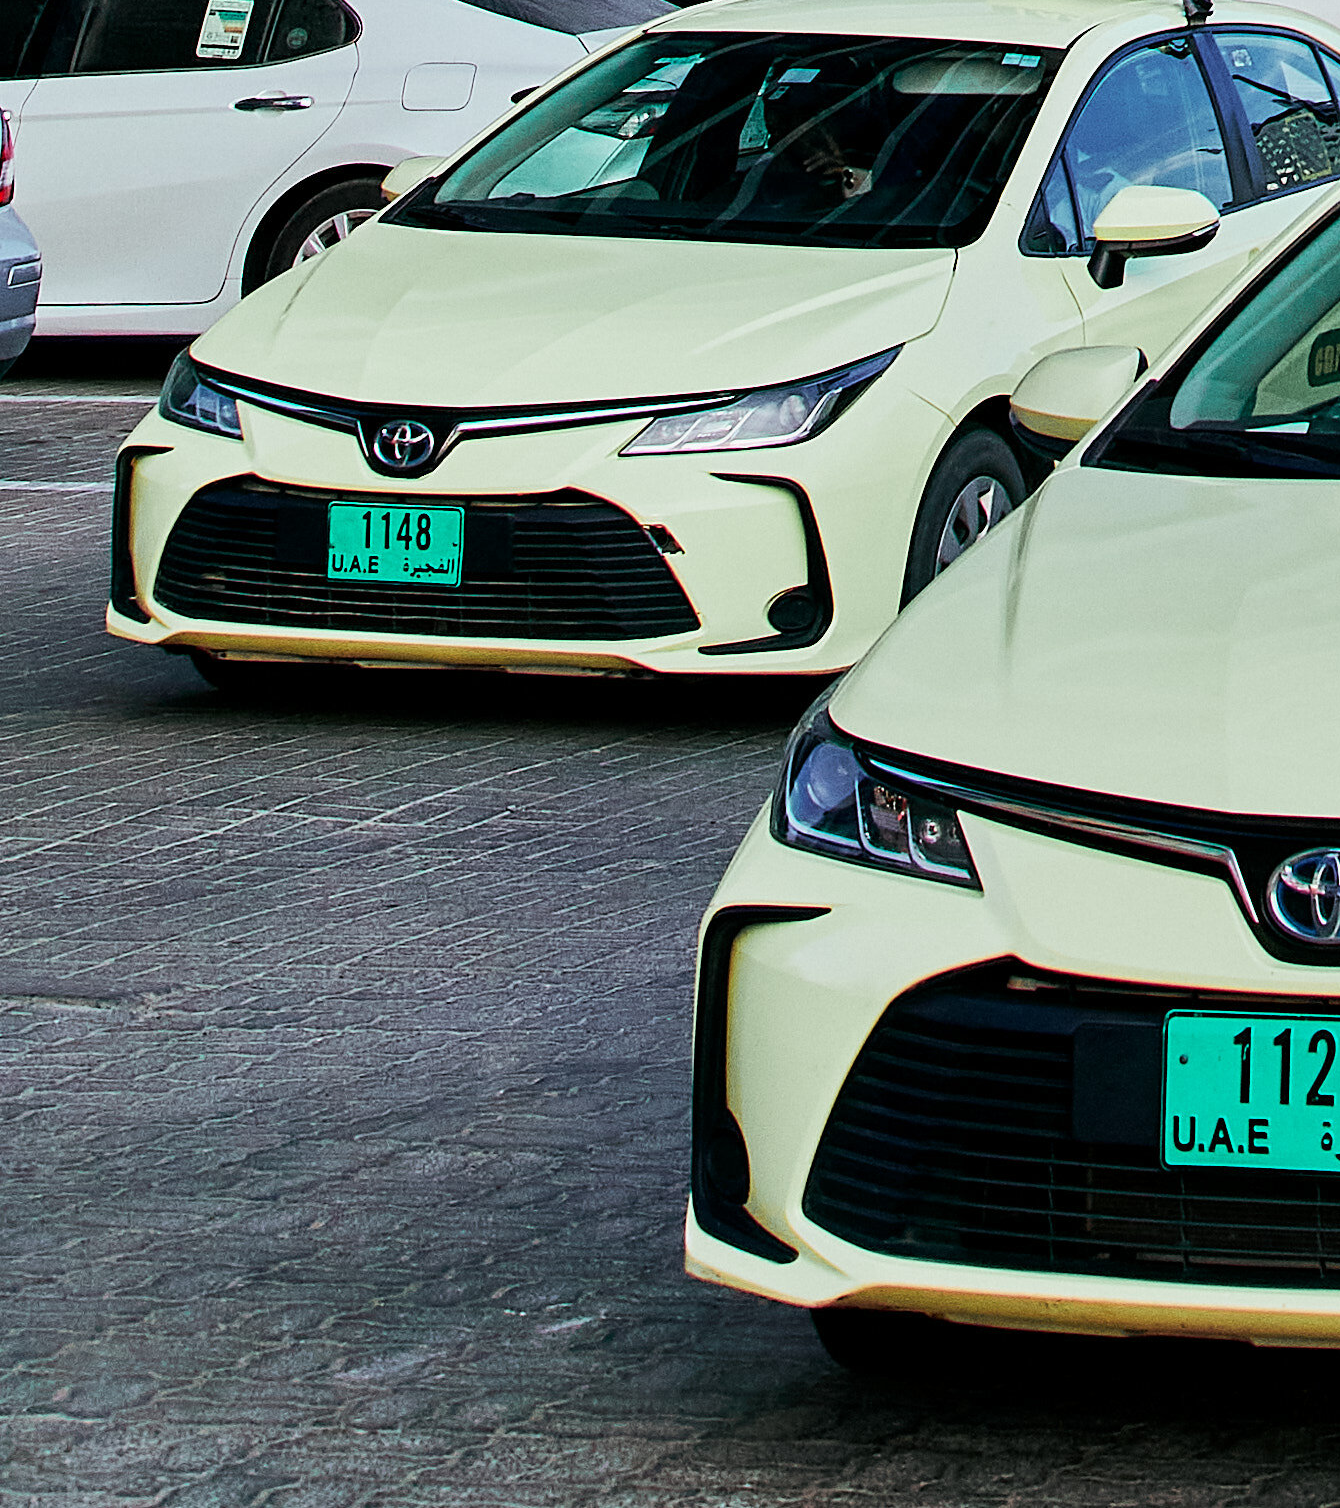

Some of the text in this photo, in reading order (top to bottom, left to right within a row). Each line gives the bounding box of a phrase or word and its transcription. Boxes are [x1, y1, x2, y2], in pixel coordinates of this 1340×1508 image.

[362, 511, 432, 551] 1148
[332, 553, 379, 574] U.A.E
[403, 557, 455, 579] الفجيرة
[1172, 1115, 1270, 1155] U.A.E
